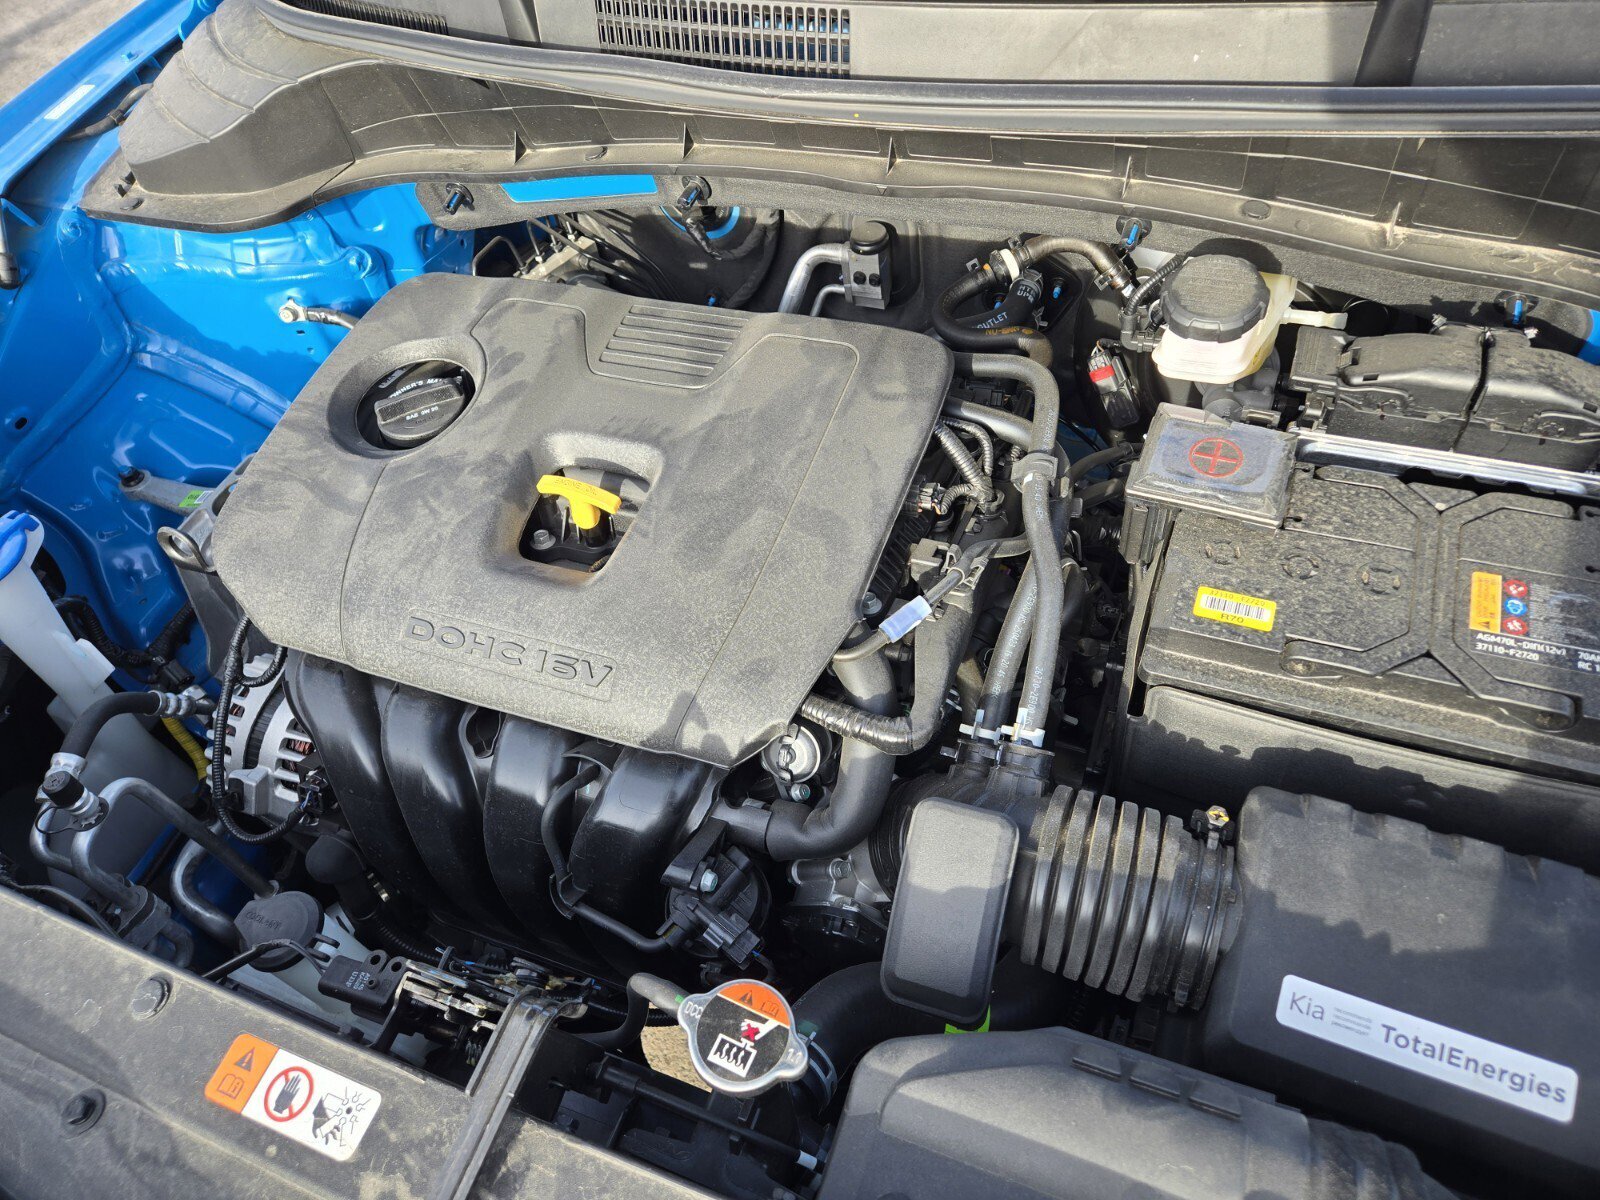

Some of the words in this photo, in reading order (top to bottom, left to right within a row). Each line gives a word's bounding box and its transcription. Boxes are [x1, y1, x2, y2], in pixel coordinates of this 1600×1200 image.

[1220, 613, 1245, 624] R70
[405, 616, 526, 665] DOHC
[535, 649, 613, 688] 16V
[1475, 643, 1540, 661] 37110-F2720
[1289, 992, 1325, 1021] Kia
[1381, 1023, 1567, 1104] TotalEnergies
